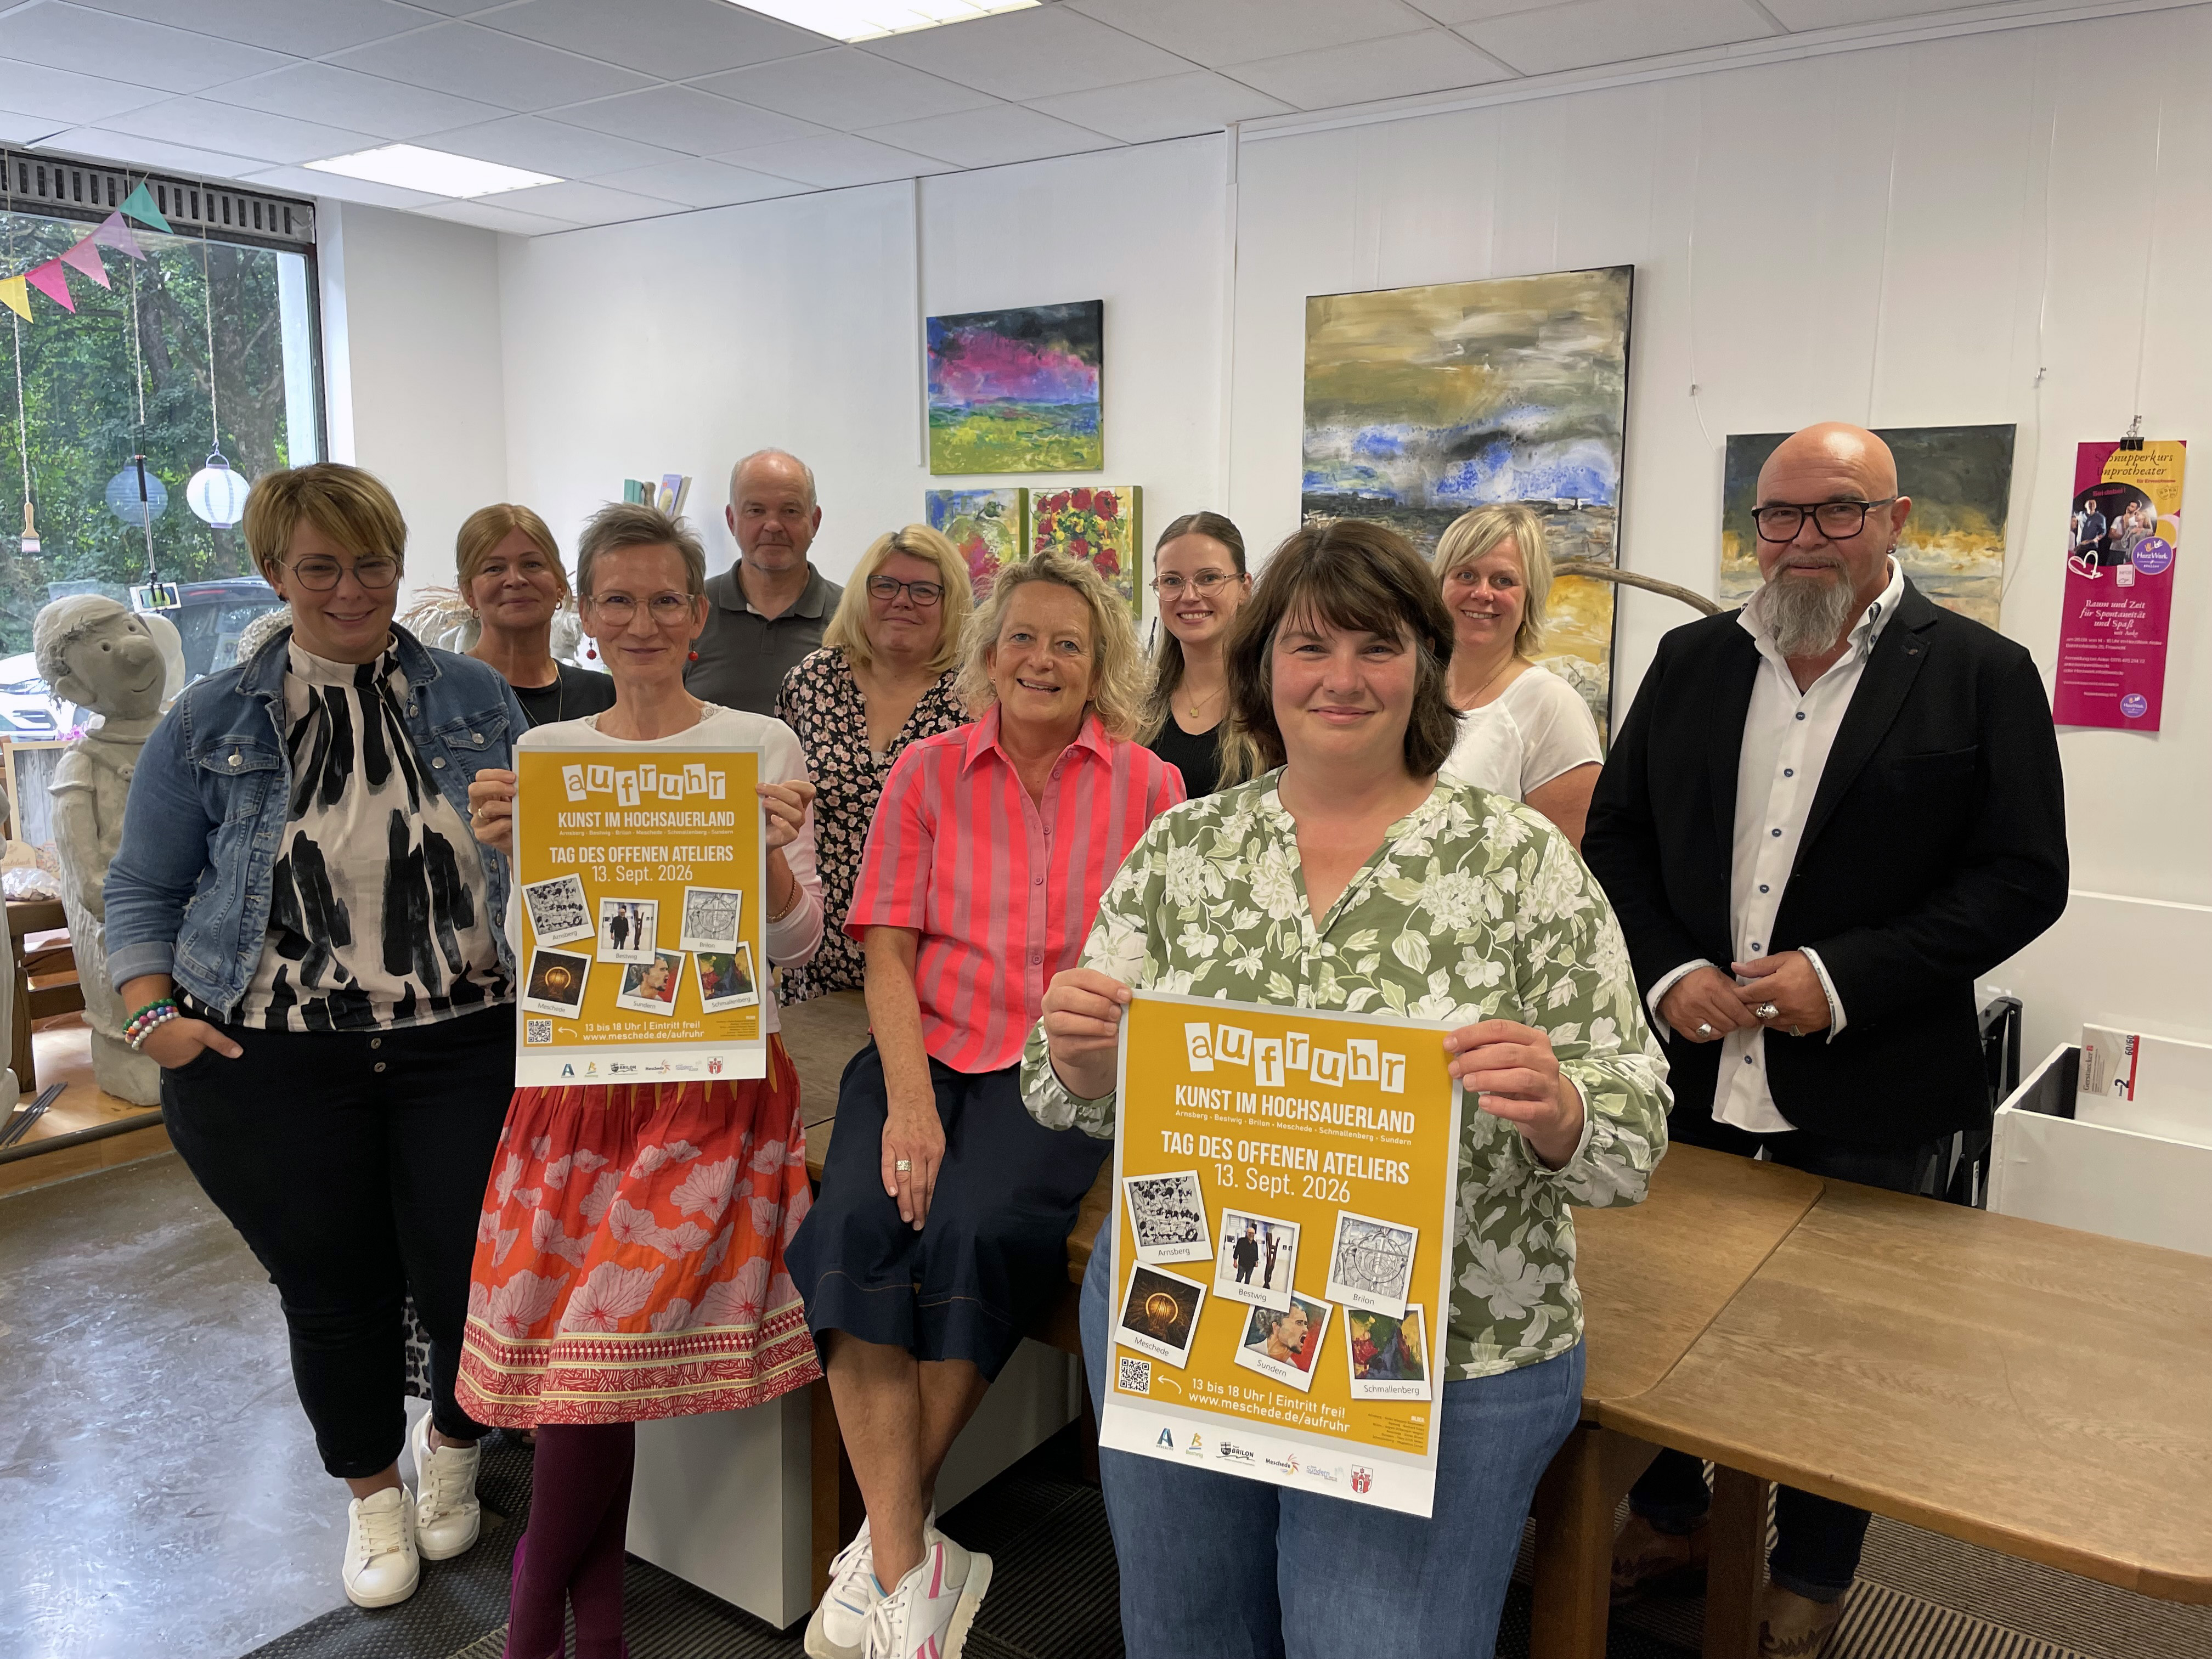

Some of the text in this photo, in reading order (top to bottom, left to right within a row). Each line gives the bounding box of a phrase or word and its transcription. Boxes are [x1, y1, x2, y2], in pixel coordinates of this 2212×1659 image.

[2111, 599, 2128, 608] und
[2079, 608, 2094, 618] für
[2095, 618, 2134, 630] und Spaß
[569, 768, 724, 802] aufruhr
[558, 811, 735, 828] KUNST IM HOCHSAUERLAND
[550, 845, 733, 863] TAG DES OFFENEN ATELIERS
[592, 865, 693, 885] 13. Sept. 2026
[552, 930, 578, 940] Arnsberg
[538, 1003, 566, 1013] Meschede
[634, 1001, 656, 1009] Sundern
[712, 996, 751, 1008] Schmallenberg
[624, 1022, 641, 1030] Uhr
[650, 1022, 680, 1030] Eintritt
[583, 1030, 704, 1040] www.meschede.de/aufruhr
[1192, 1029, 1404, 1087] aufruhr
[1176, 1085, 1414, 1134] KUNST IM HOCHSAUERLAND
[1175, 1109, 1411, 1145] Arnsberg Bestwig Brilon Meschede Schmallenberg Sundern
[1161, 1131, 1409, 1185] TAG DES OFFENEN ATELIERS
[1215, 1164, 1350, 1203] 13. Sept. 2026
[1158, 1246, 1190, 1257] Arnsberg
[1238, 1289, 1267, 1302] Bestwig
[1353, 1294, 1374, 1305] Brilon
[1135, 1338, 1169, 1357] Meschede
[1257, 1359, 1286, 1377] Sundern
[1363, 1385, 1419, 1396] Schmallenberg
[1192, 1379, 1205, 1390] 13
[1207, 1381, 1224, 1394] bis
[1228, 1385, 1239, 1396] 18
[1243, 1389, 1265, 1401] Uhr
[1276, 1394, 1317, 1413] Eintritt
[1321, 1403, 1345, 1417] frei!
[1189, 1393, 1350, 1432] www.meschede.de/aufruhr
[1232, 1448, 1254, 1457] BRILON
[1266, 1458, 1290, 1468] Meschede
